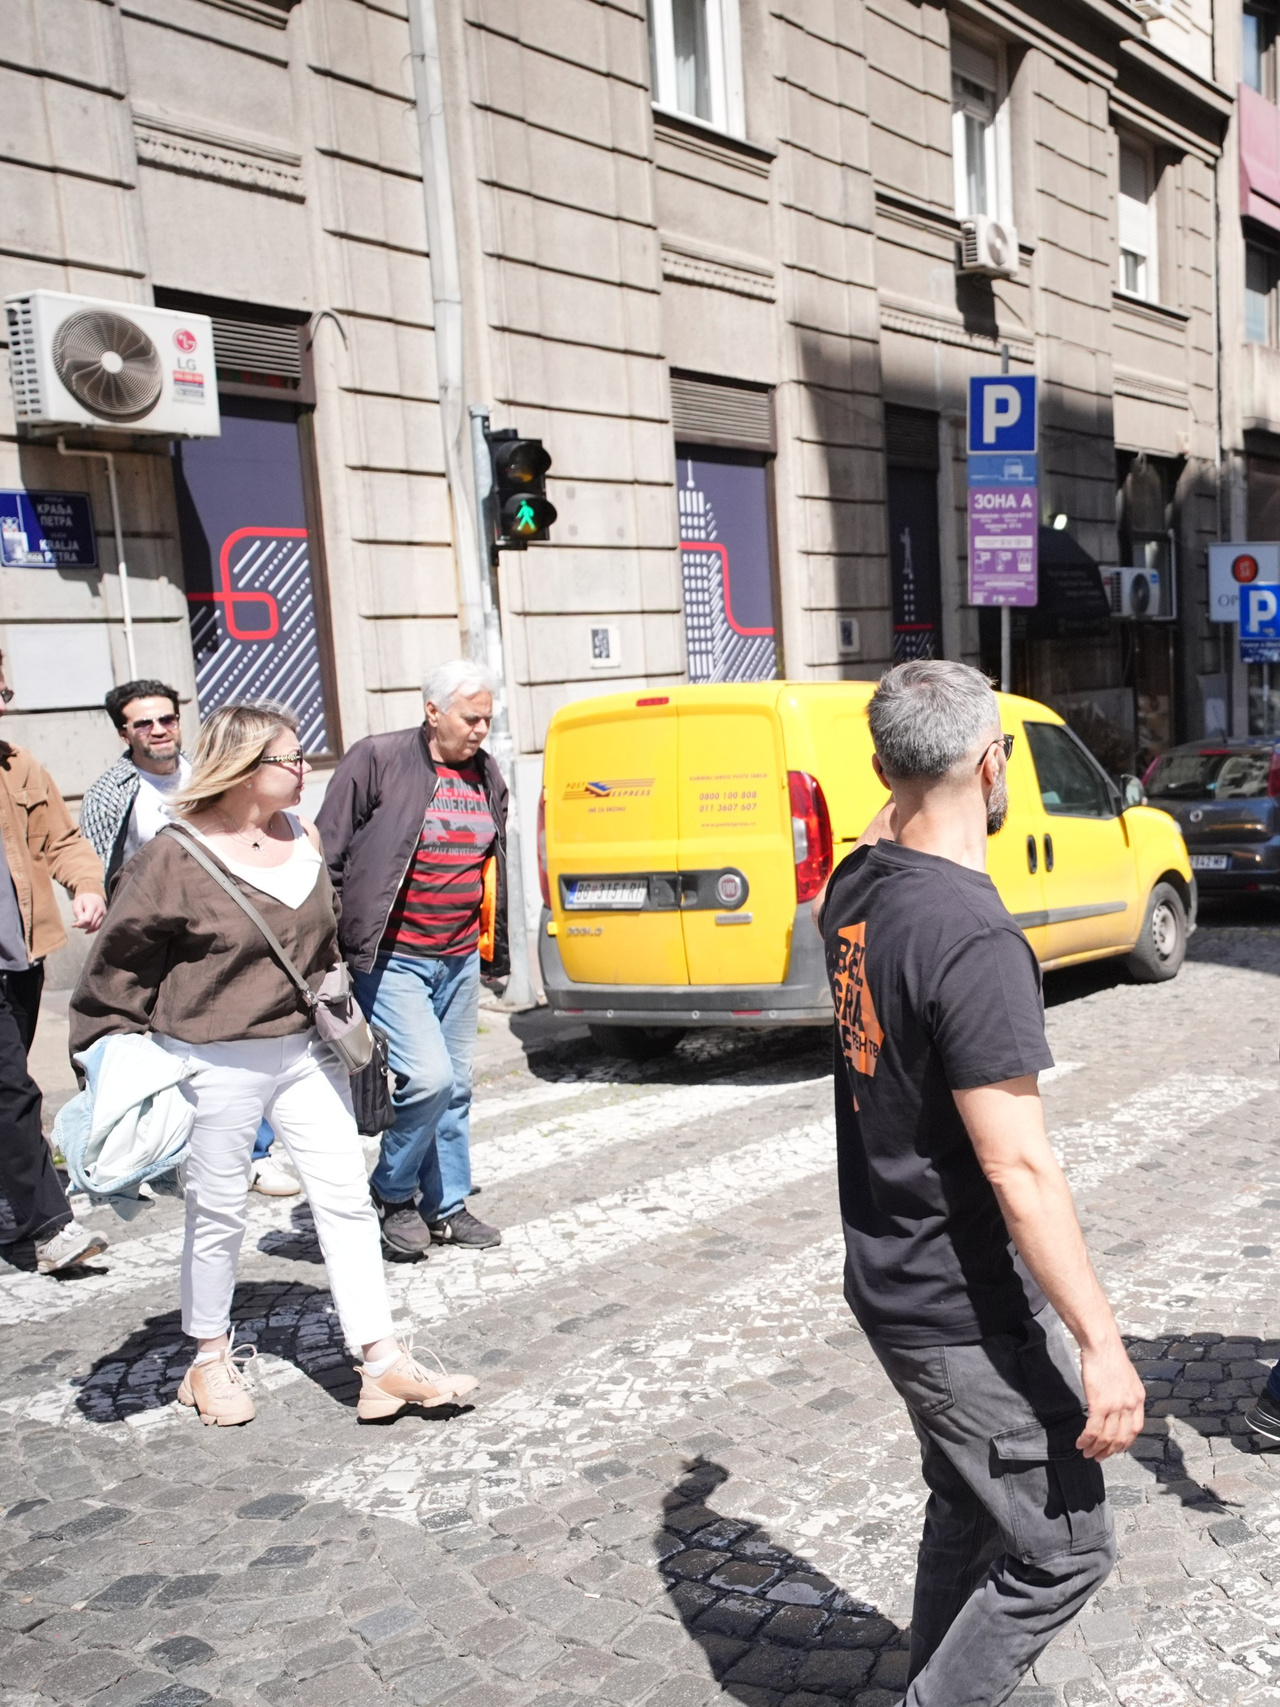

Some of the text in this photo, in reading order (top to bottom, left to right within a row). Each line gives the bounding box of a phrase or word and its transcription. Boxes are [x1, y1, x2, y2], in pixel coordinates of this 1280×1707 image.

[177, 357, 197, 371] LG
[982, 384, 1022, 444] P
[974, 493, 1033, 509] ЗОНА А
[37, 503, 73, 514] КРАЉА
[41, 515, 73, 527] ПЕТРА
[39, 539, 79, 550] KRALJA
[44, 551, 78, 562] PETRA
[1248, 590, 1278, 633] P
[611, 789, 652, 797] EXPRESS
[699, 792, 720, 800] 0800
[723, 792, 738, 800] 100
[699, 804, 714, 812] 011
[741, 802, 757, 811] 607
[576, 882, 591, 900] BG
